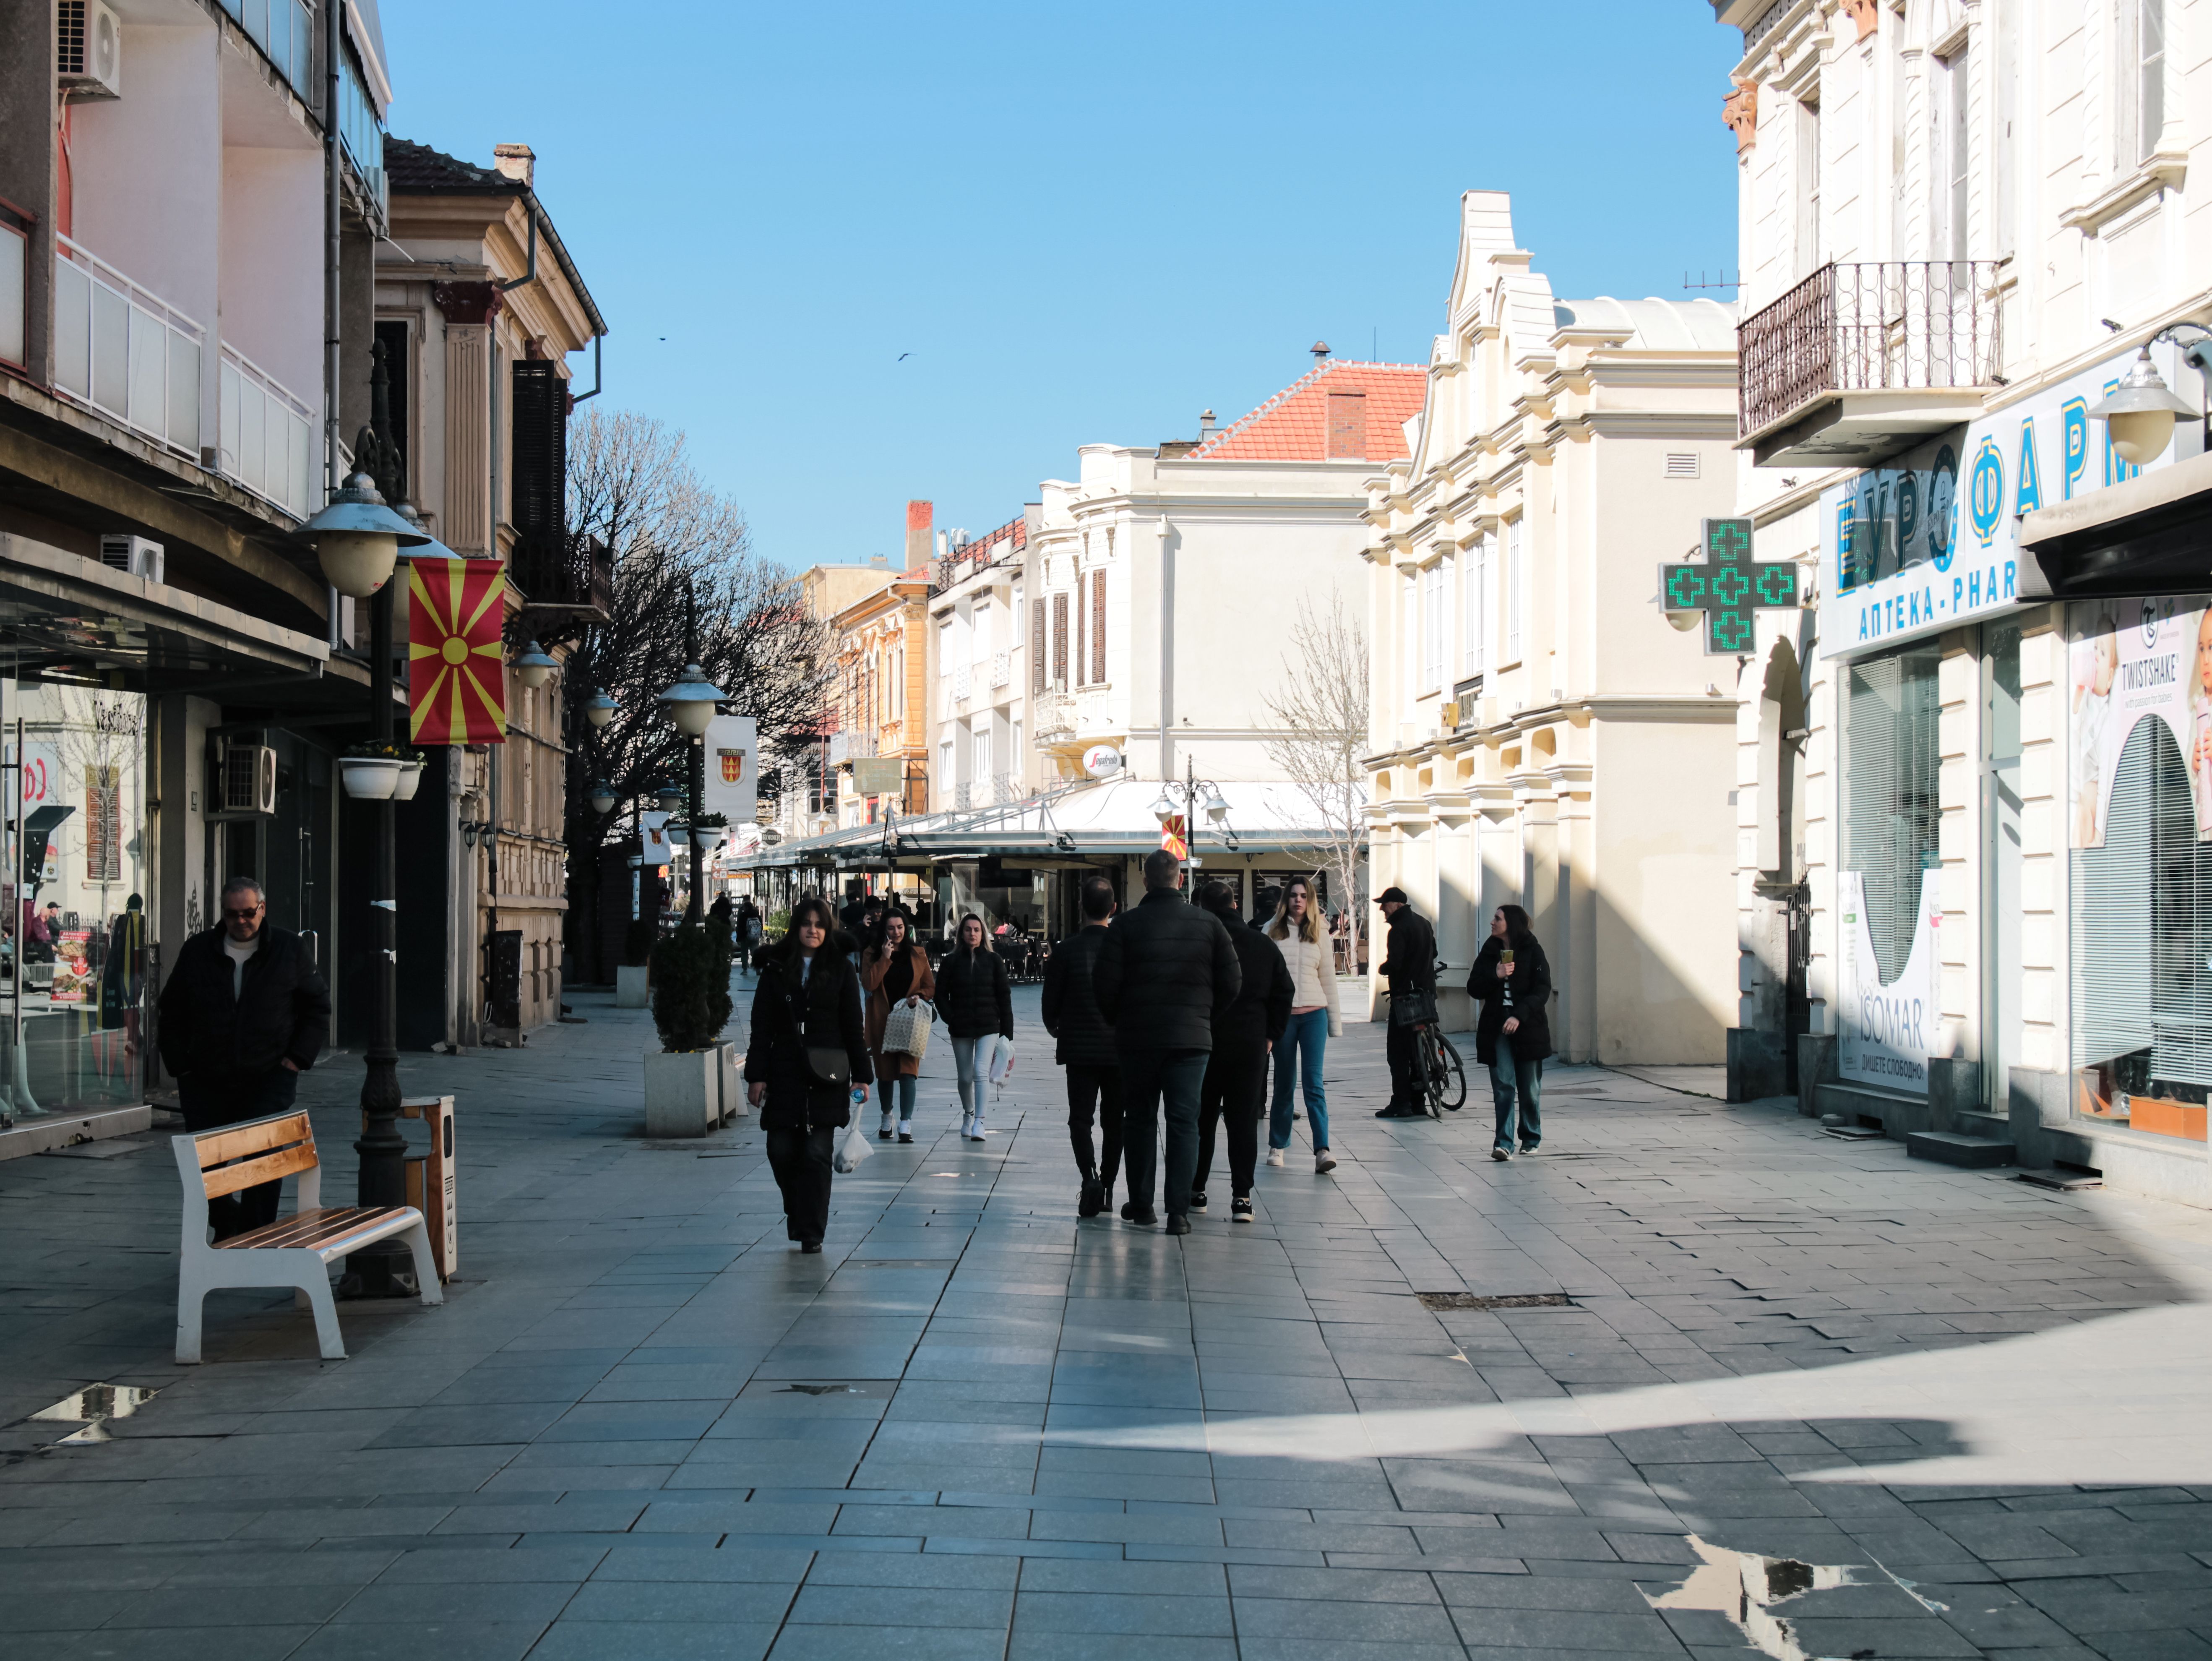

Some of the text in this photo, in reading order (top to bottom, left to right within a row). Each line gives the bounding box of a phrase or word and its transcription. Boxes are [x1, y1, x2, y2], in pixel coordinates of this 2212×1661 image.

[1859, 586, 1933, 641] АПТЕКА
[2122, 654, 2175, 691] TWISTSHAKE
[1089, 753, 1118, 768] Segafredo
[1860, 994, 1924, 1050] ISOMAR
[1862, 1053, 1924, 1082] ДИШЕТЕ СЛОБОДНО!
